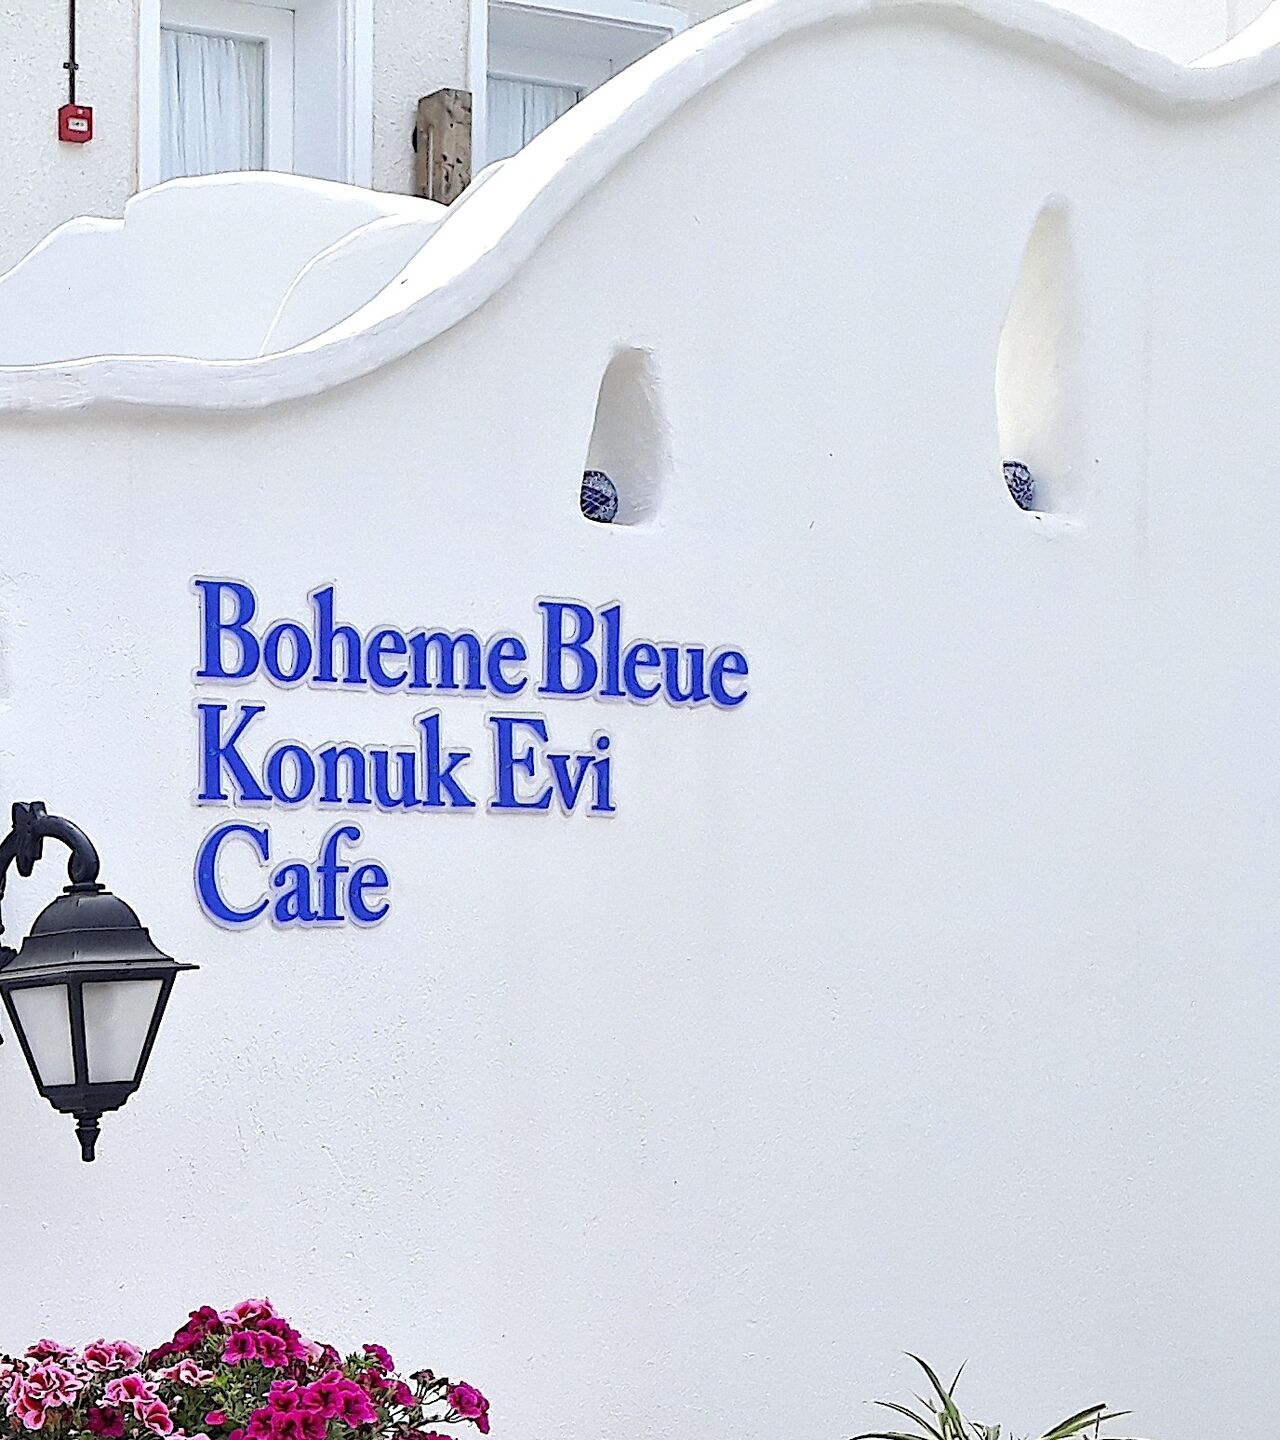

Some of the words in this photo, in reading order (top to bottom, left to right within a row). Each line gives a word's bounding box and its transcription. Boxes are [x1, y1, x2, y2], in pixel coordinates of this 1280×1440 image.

[195, 579, 528, 697] Boheme
[537, 600, 750, 708] Bleue
[197, 703, 476, 810] Konuk
[490, 716, 615, 813] Evi
[196, 823, 390, 926] Cafe
